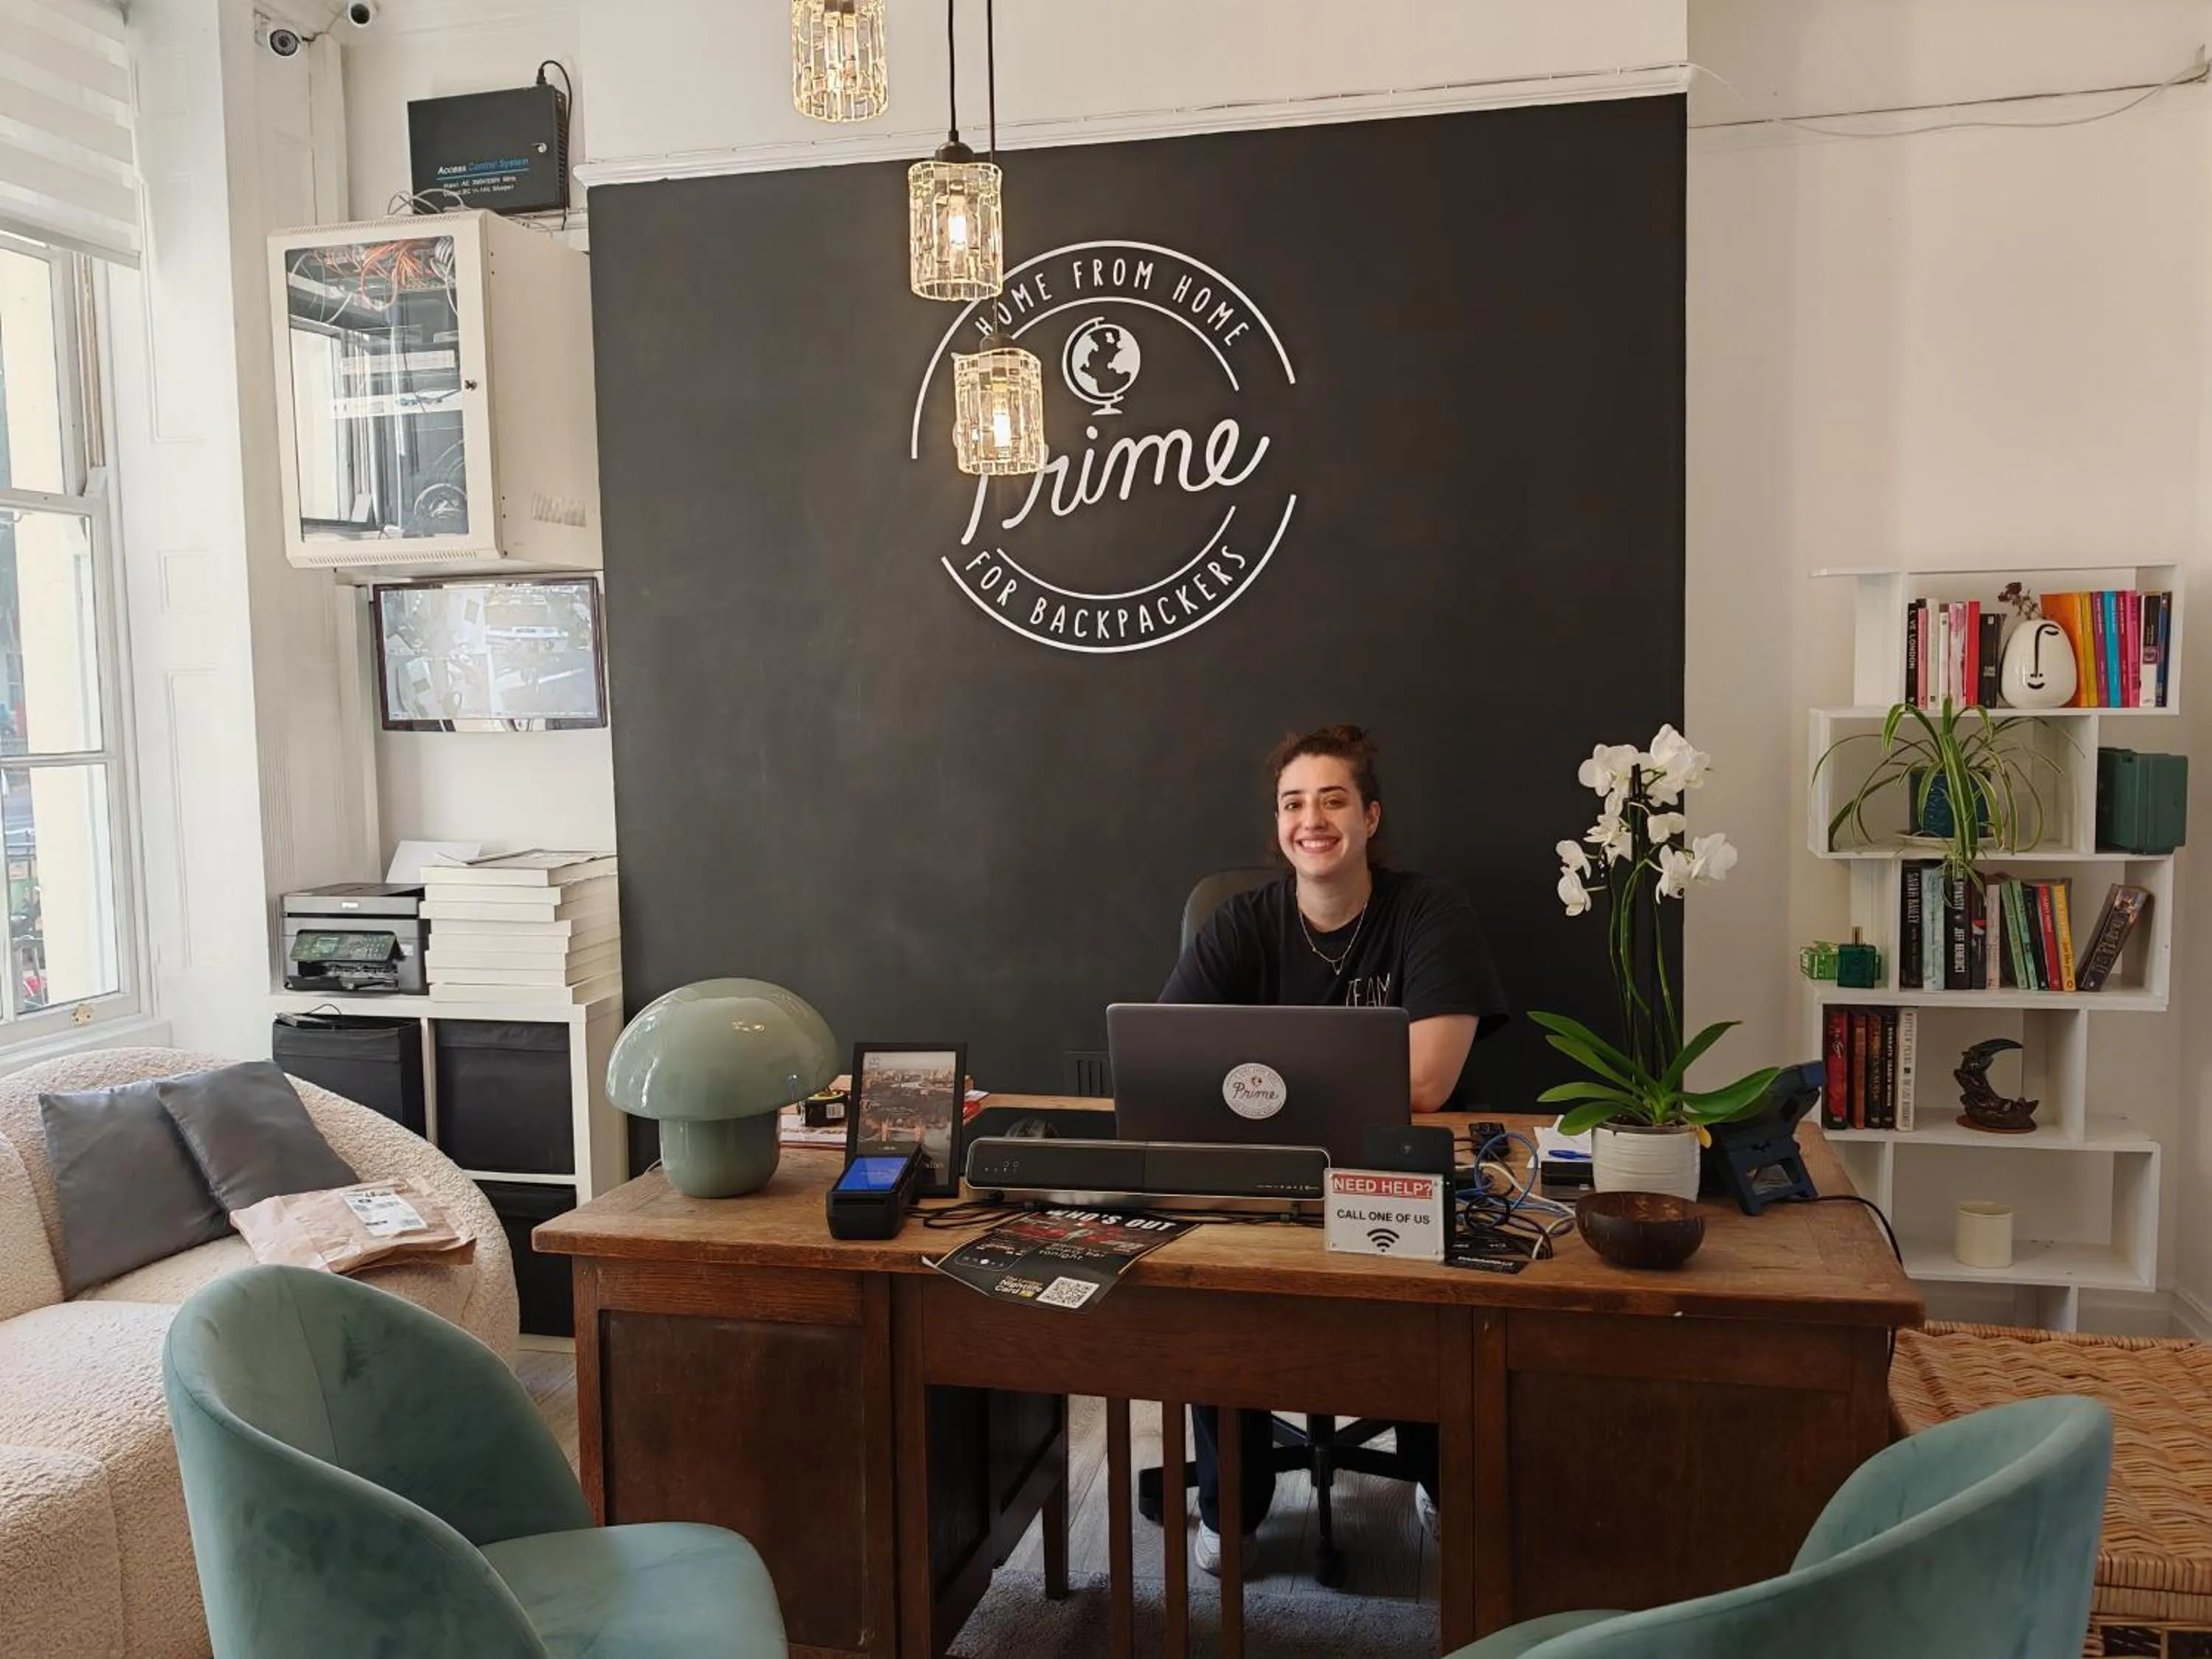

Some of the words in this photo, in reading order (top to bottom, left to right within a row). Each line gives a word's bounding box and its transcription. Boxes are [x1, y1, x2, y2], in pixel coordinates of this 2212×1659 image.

[437, 164, 467, 175] Access
[975, 273, 1052, 334] HOME
[1073, 258, 1154, 290] FROM
[1172, 276, 1250, 347] HOME
[966, 551, 1018, 607] FOR
[1030, 545, 1246, 640] BACKPACKERS
[1954, 928, 1965, 942] JEFF
[1346, 973, 1391, 1007] TEAM
[1232, 1082, 1279, 1099] Prime
[1333, 1178, 1377, 1193] NEED
[1381, 1180, 1433, 1196] HELP?
[1046, 1210, 1122, 1225] WHO'S
[1124, 1219, 1177, 1231] OUT
[1336, 1208, 1366, 1221] CALL
[1368, 1211, 1393, 1222] ONE
[1396, 1213, 1411, 1223] OF
[1414, 1214, 1430, 1225] US
[995, 1285, 1022, 1295] Card
